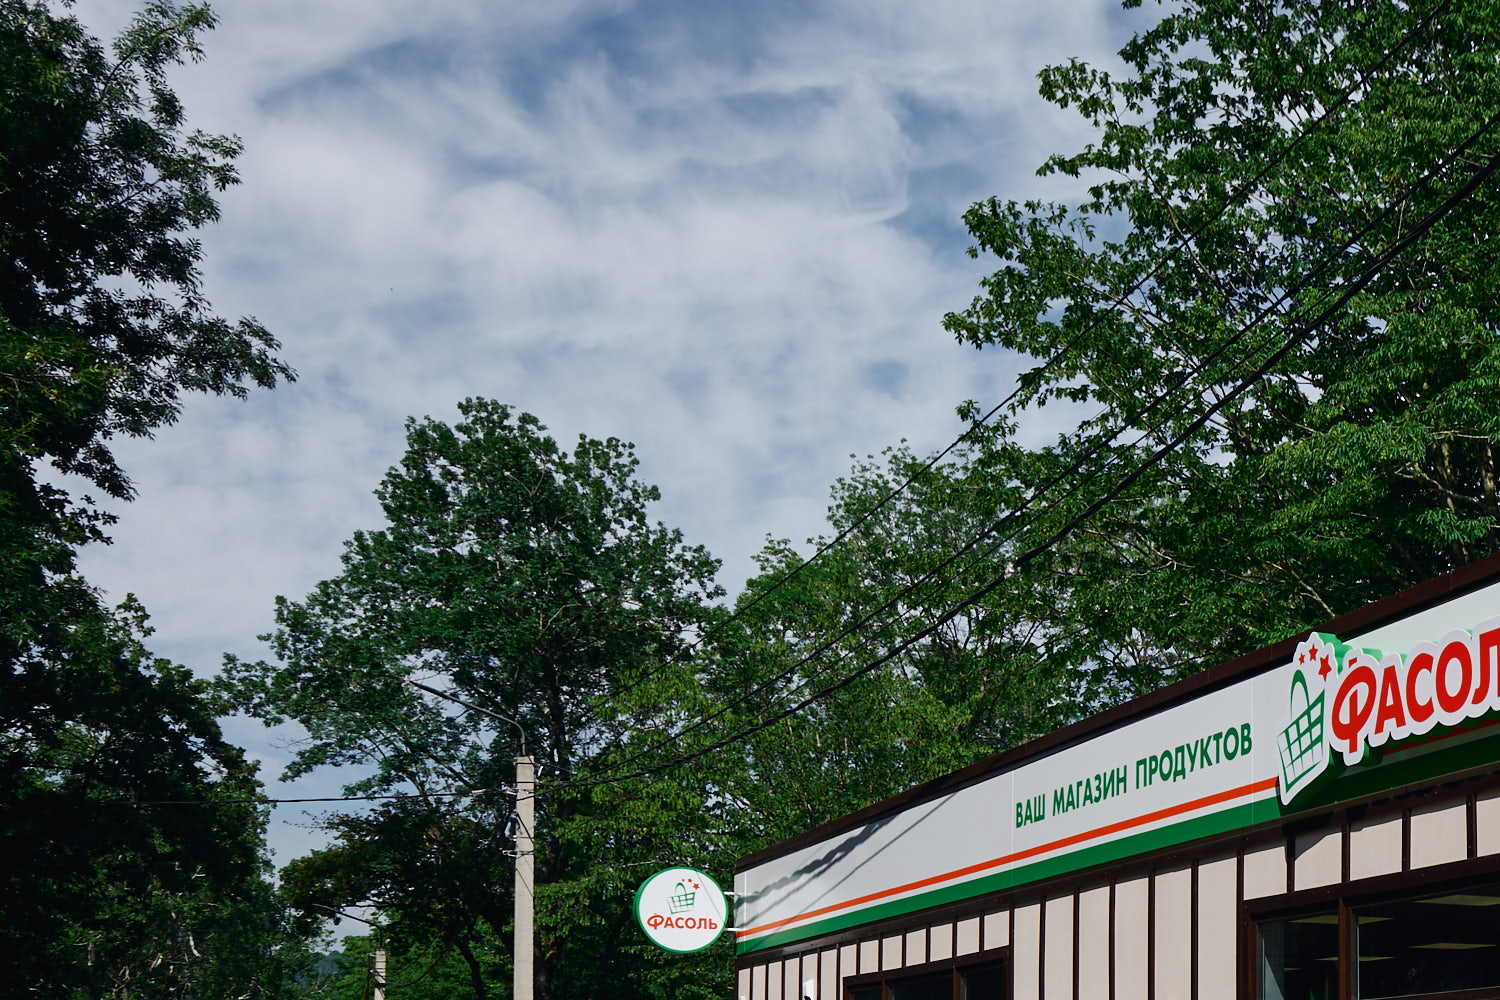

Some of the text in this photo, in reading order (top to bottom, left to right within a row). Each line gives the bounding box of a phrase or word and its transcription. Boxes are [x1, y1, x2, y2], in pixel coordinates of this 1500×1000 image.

[1016, 722, 1253, 828] ВАШ МАГАЗИН ПРОДУКТОВ
[647, 913, 718, 930] ФАСОЛЬ
